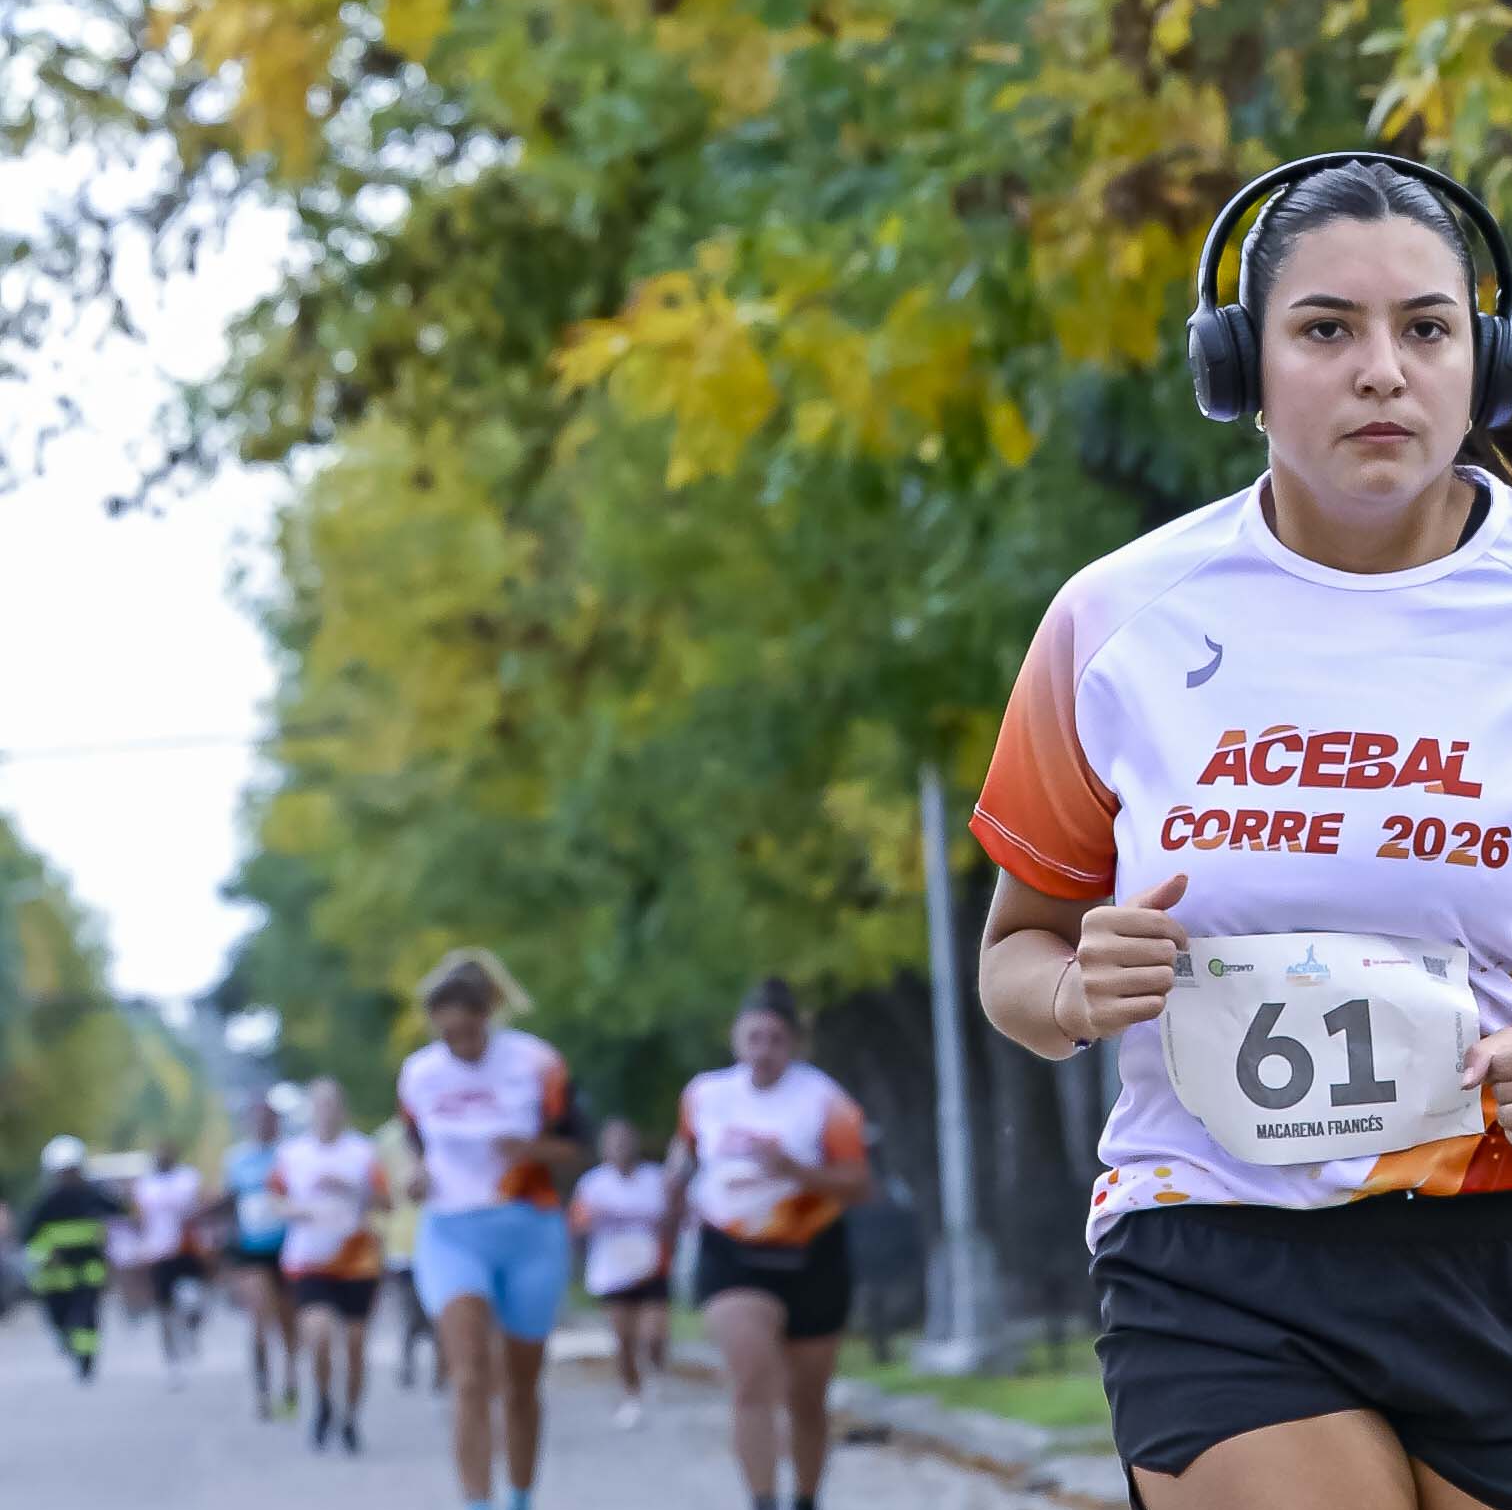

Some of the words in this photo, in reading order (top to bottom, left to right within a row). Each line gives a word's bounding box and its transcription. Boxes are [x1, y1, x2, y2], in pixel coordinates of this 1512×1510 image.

[1196, 724, 1483, 799] ACEBAL
[1160, 805, 1345, 855] CORRE
[1375, 815, 1512, 869] 2026
[1235, 998, 1398, 1110] 61
[1256, 1121, 1325, 1140] MACARENA
[1327, 1114, 1384, 1136] FRANCÉS
